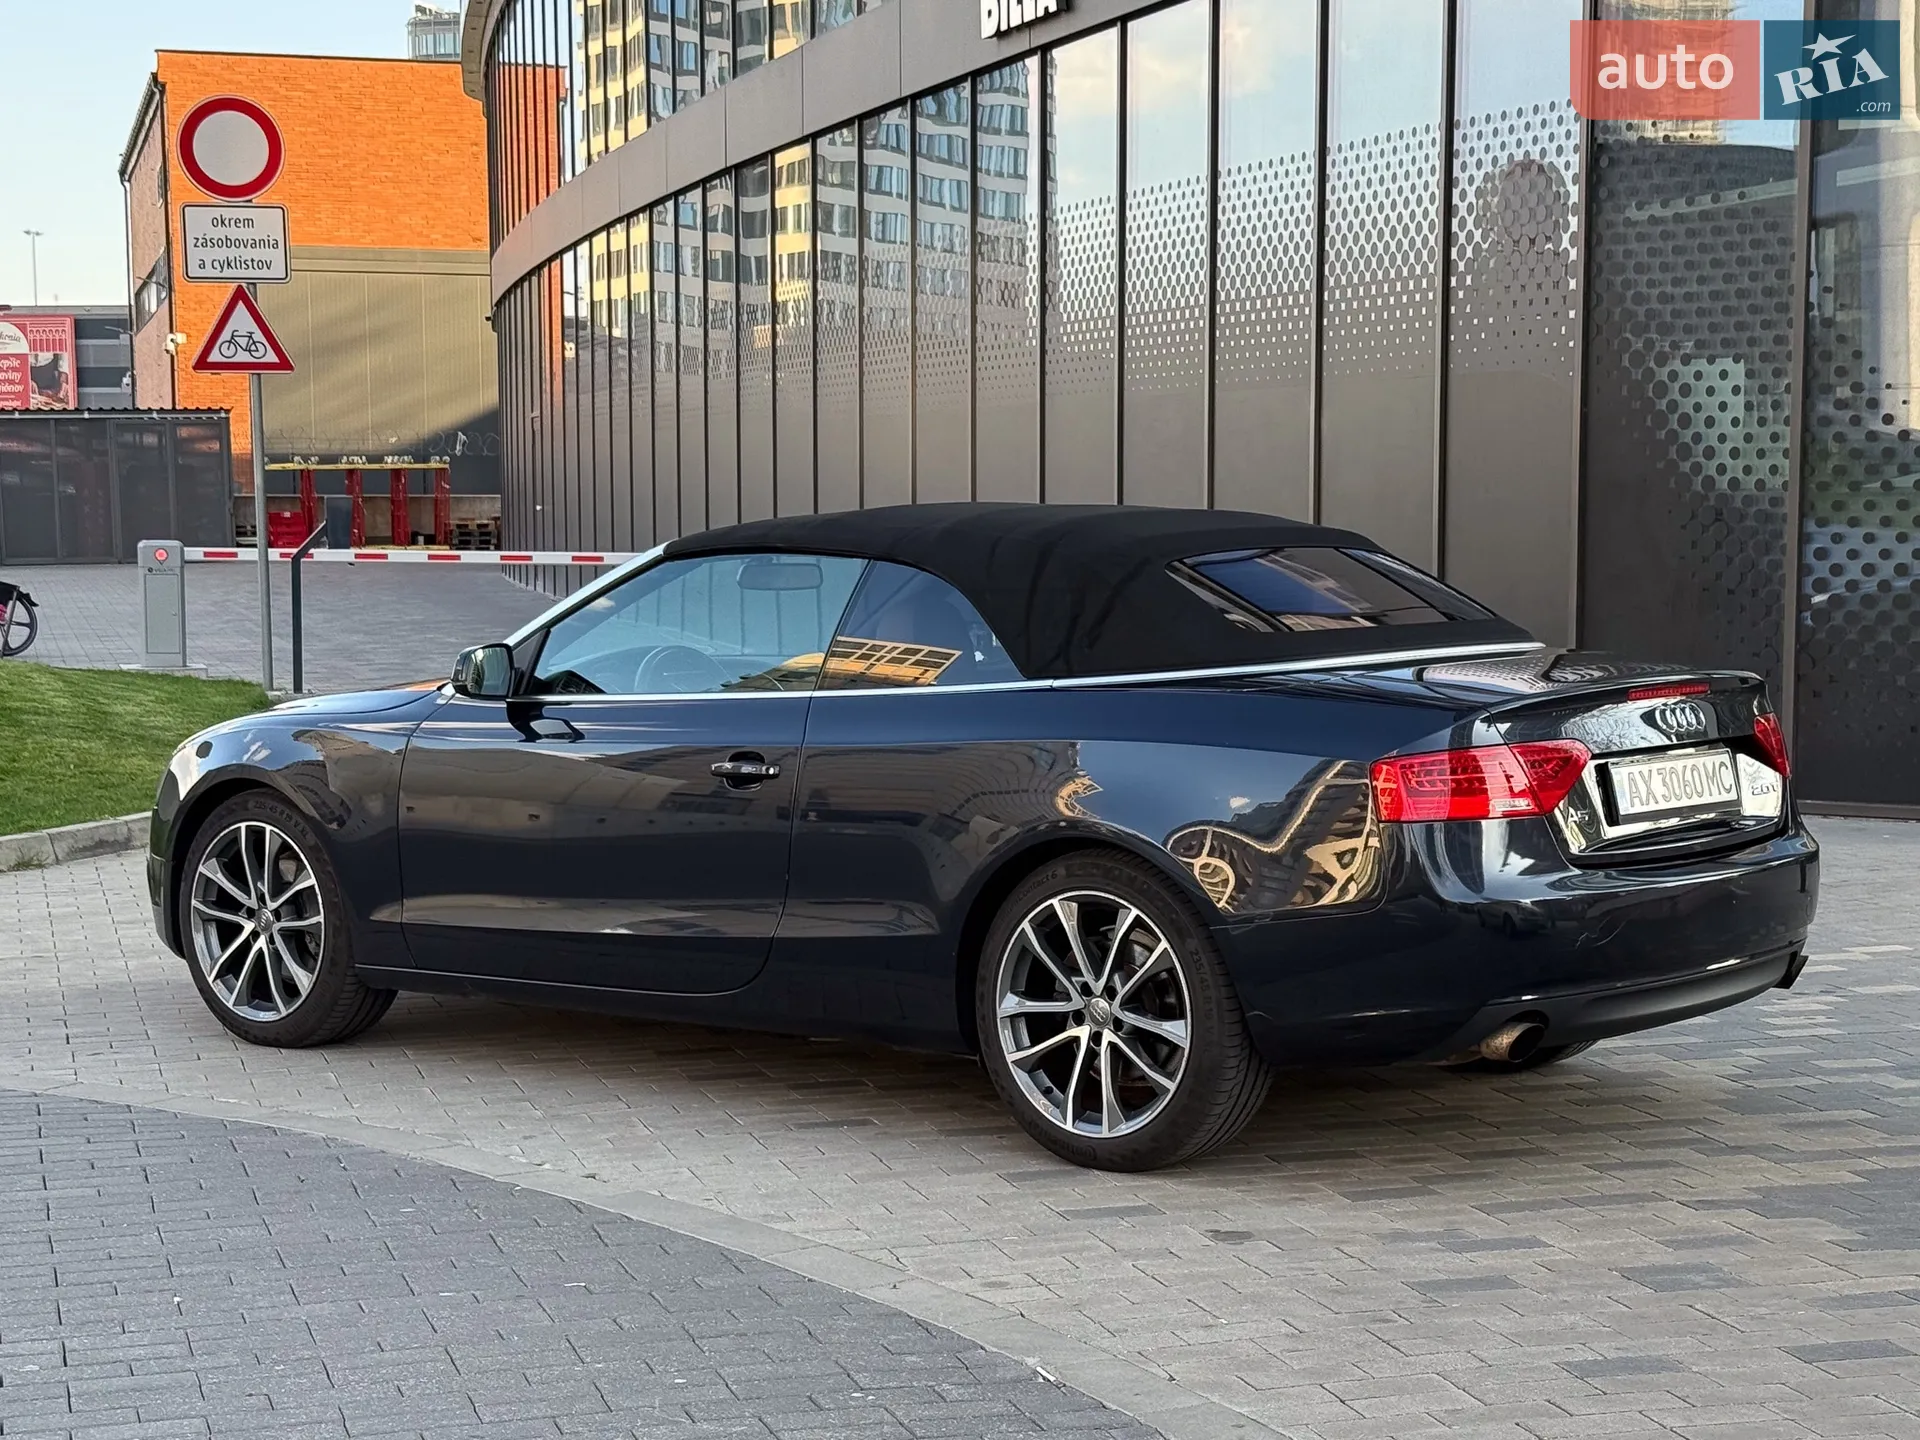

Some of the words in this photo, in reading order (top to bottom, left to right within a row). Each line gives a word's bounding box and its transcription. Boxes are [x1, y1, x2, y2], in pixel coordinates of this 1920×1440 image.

[211, 213, 255, 229] okrem
[193, 233, 279, 250] zásobovania
[198, 258, 206, 270] a
[211, 255, 273, 273] cyklistov
